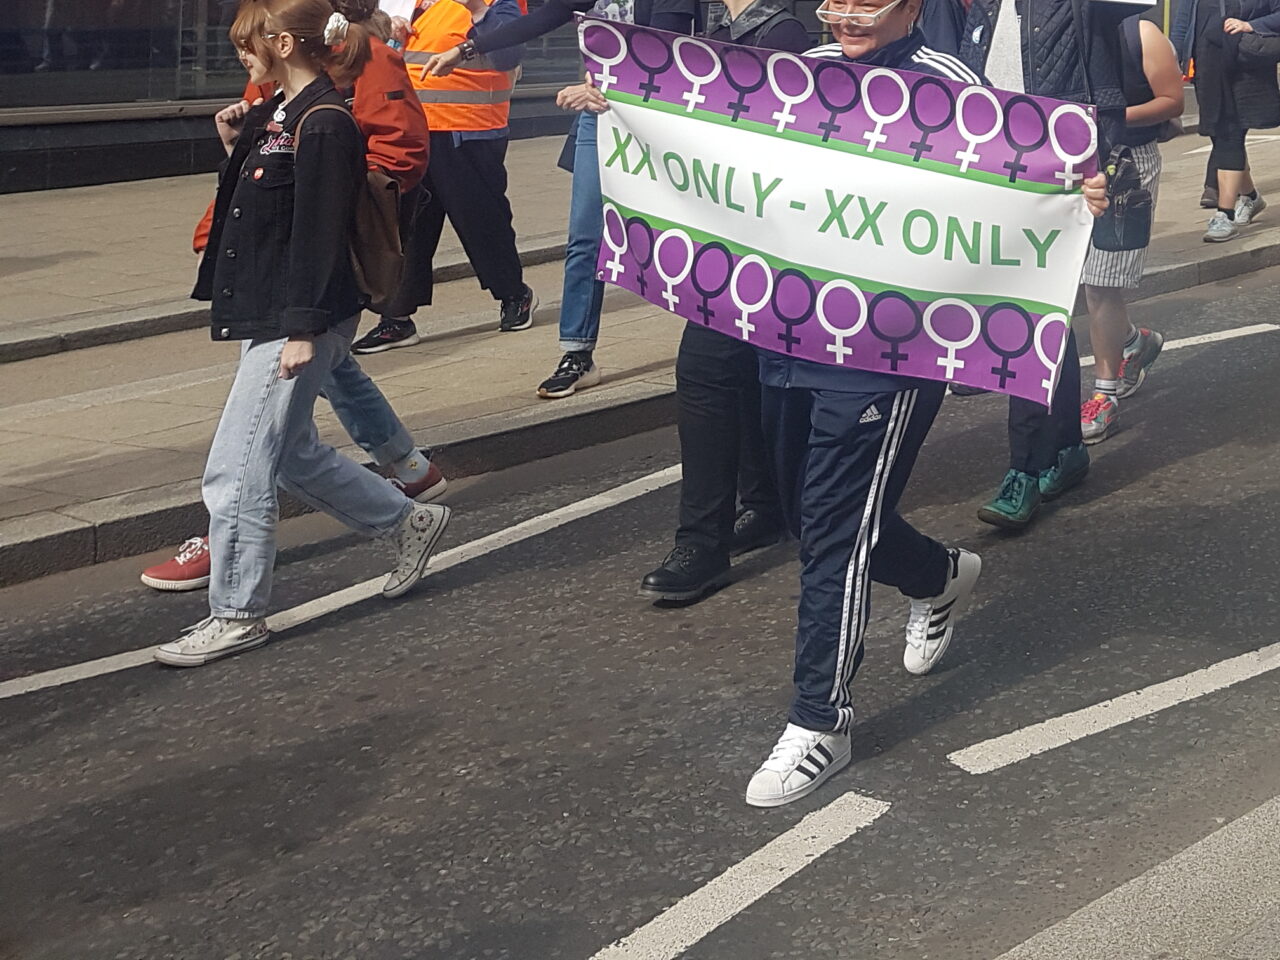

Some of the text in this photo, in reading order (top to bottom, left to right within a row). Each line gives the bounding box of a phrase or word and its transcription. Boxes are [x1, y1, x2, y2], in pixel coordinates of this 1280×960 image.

[605, 126, 657, 182] XX
[663, 150, 783, 219] ONLY
[817, 188, 888, 247] XX
[902, 208, 1061, 269] ONLY
